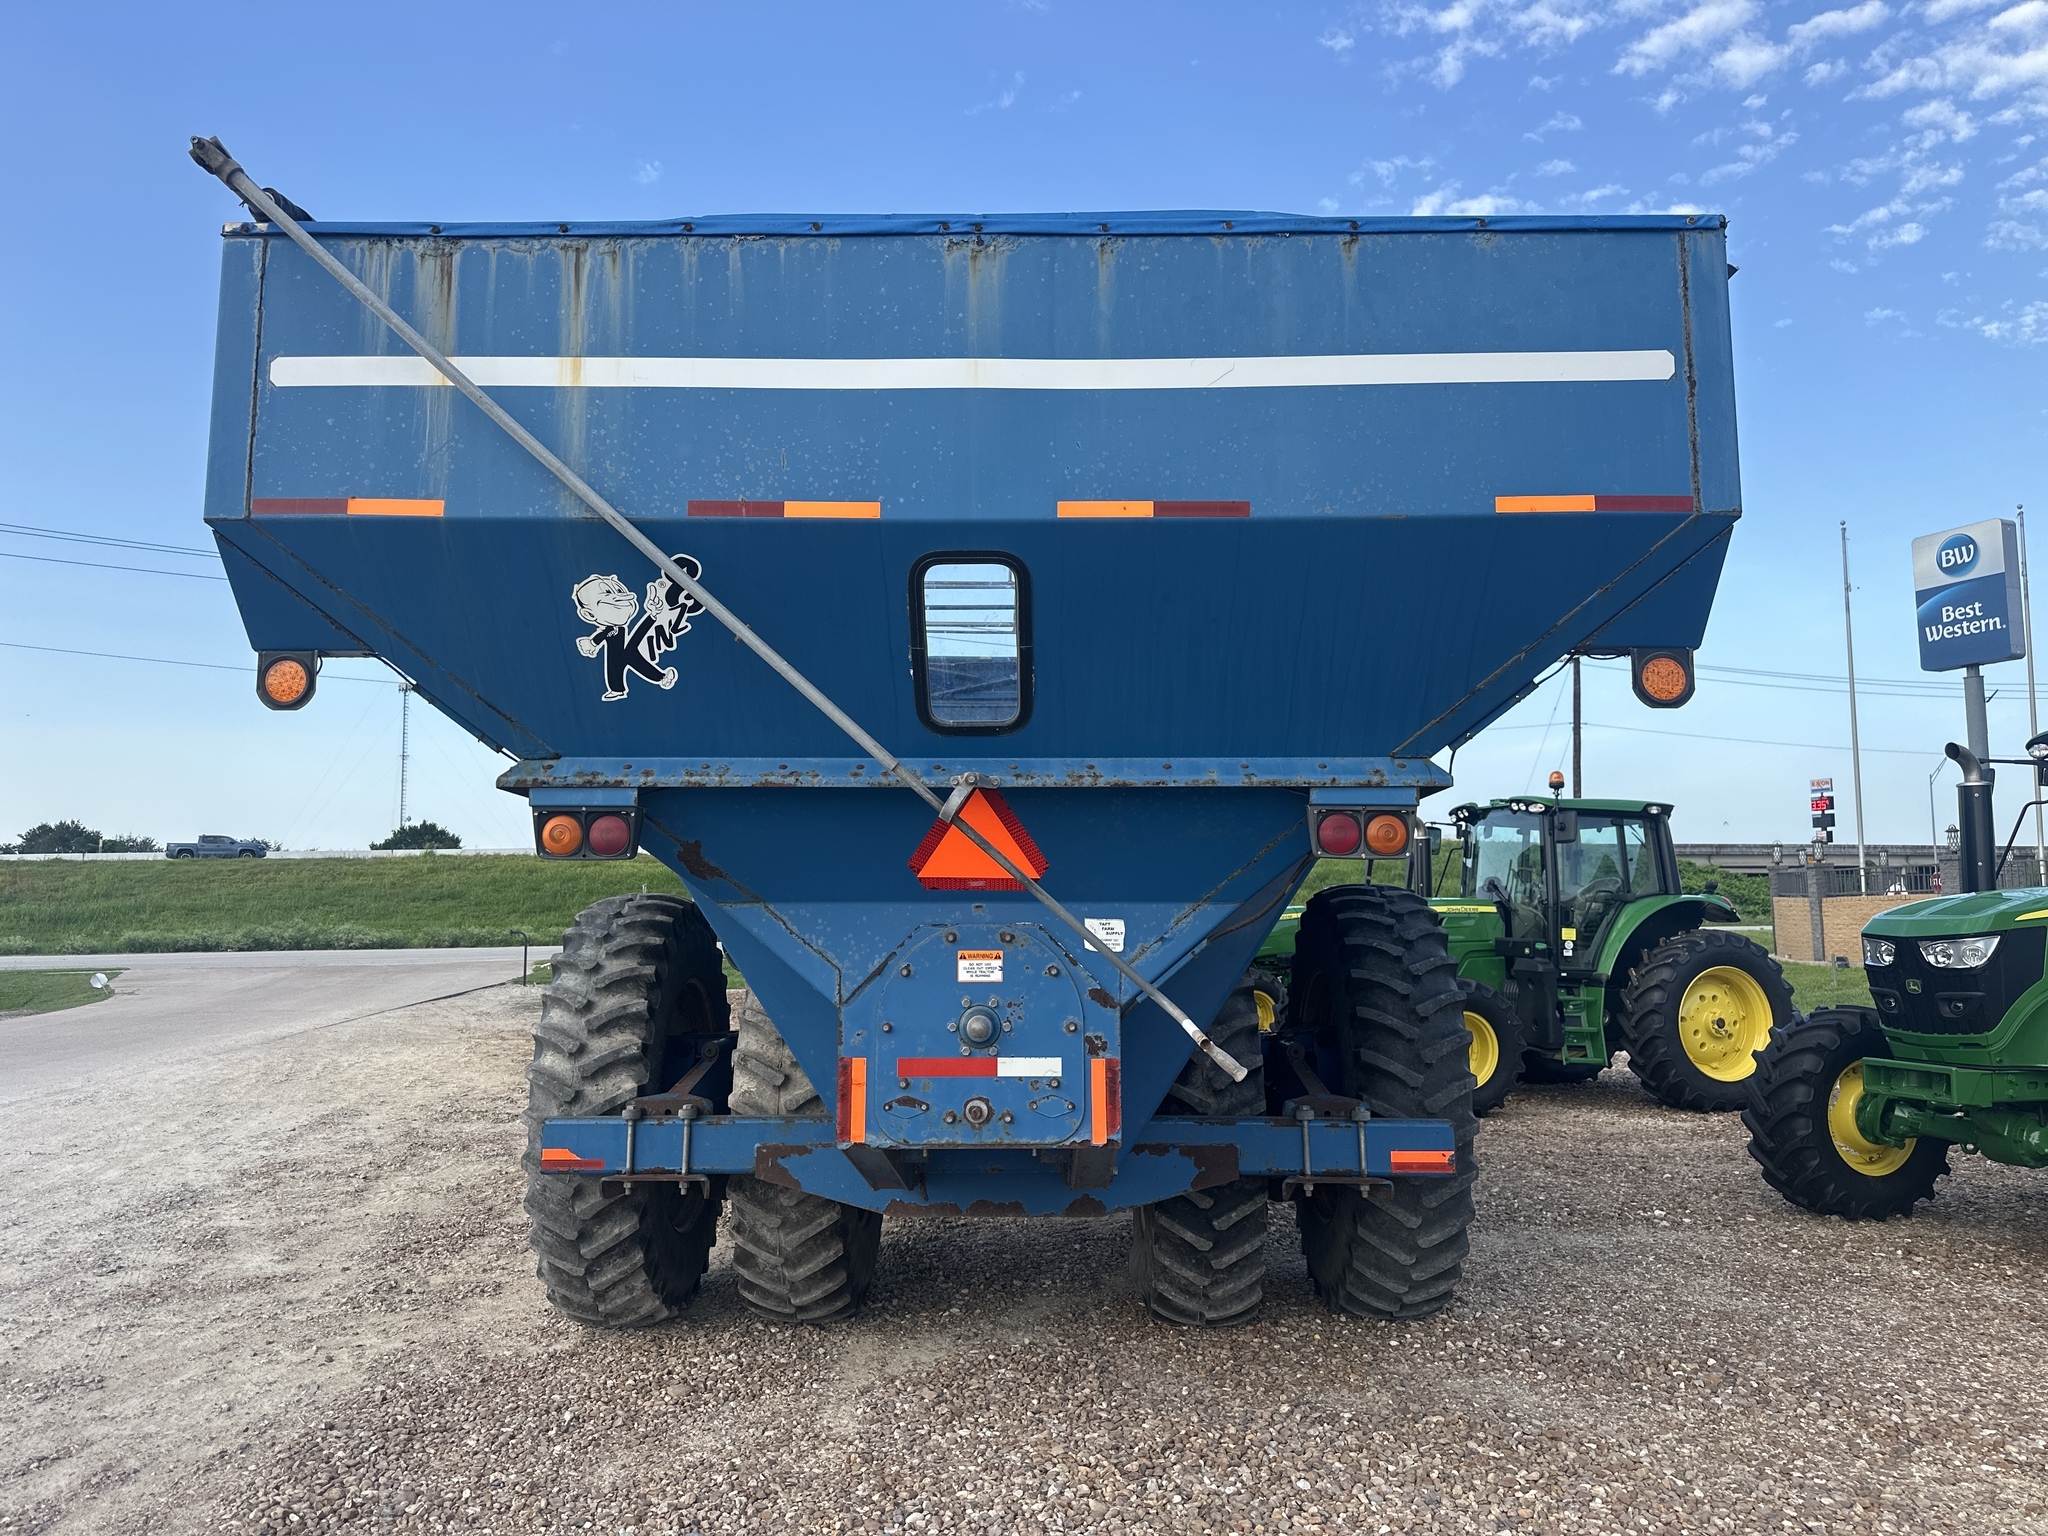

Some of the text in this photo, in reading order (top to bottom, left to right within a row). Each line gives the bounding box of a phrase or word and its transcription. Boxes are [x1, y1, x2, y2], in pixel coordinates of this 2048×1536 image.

[1941, 544, 1974, 568] BW
[1941, 601, 1983, 623] Best
[1811, 780, 1830, 788] EXXON
